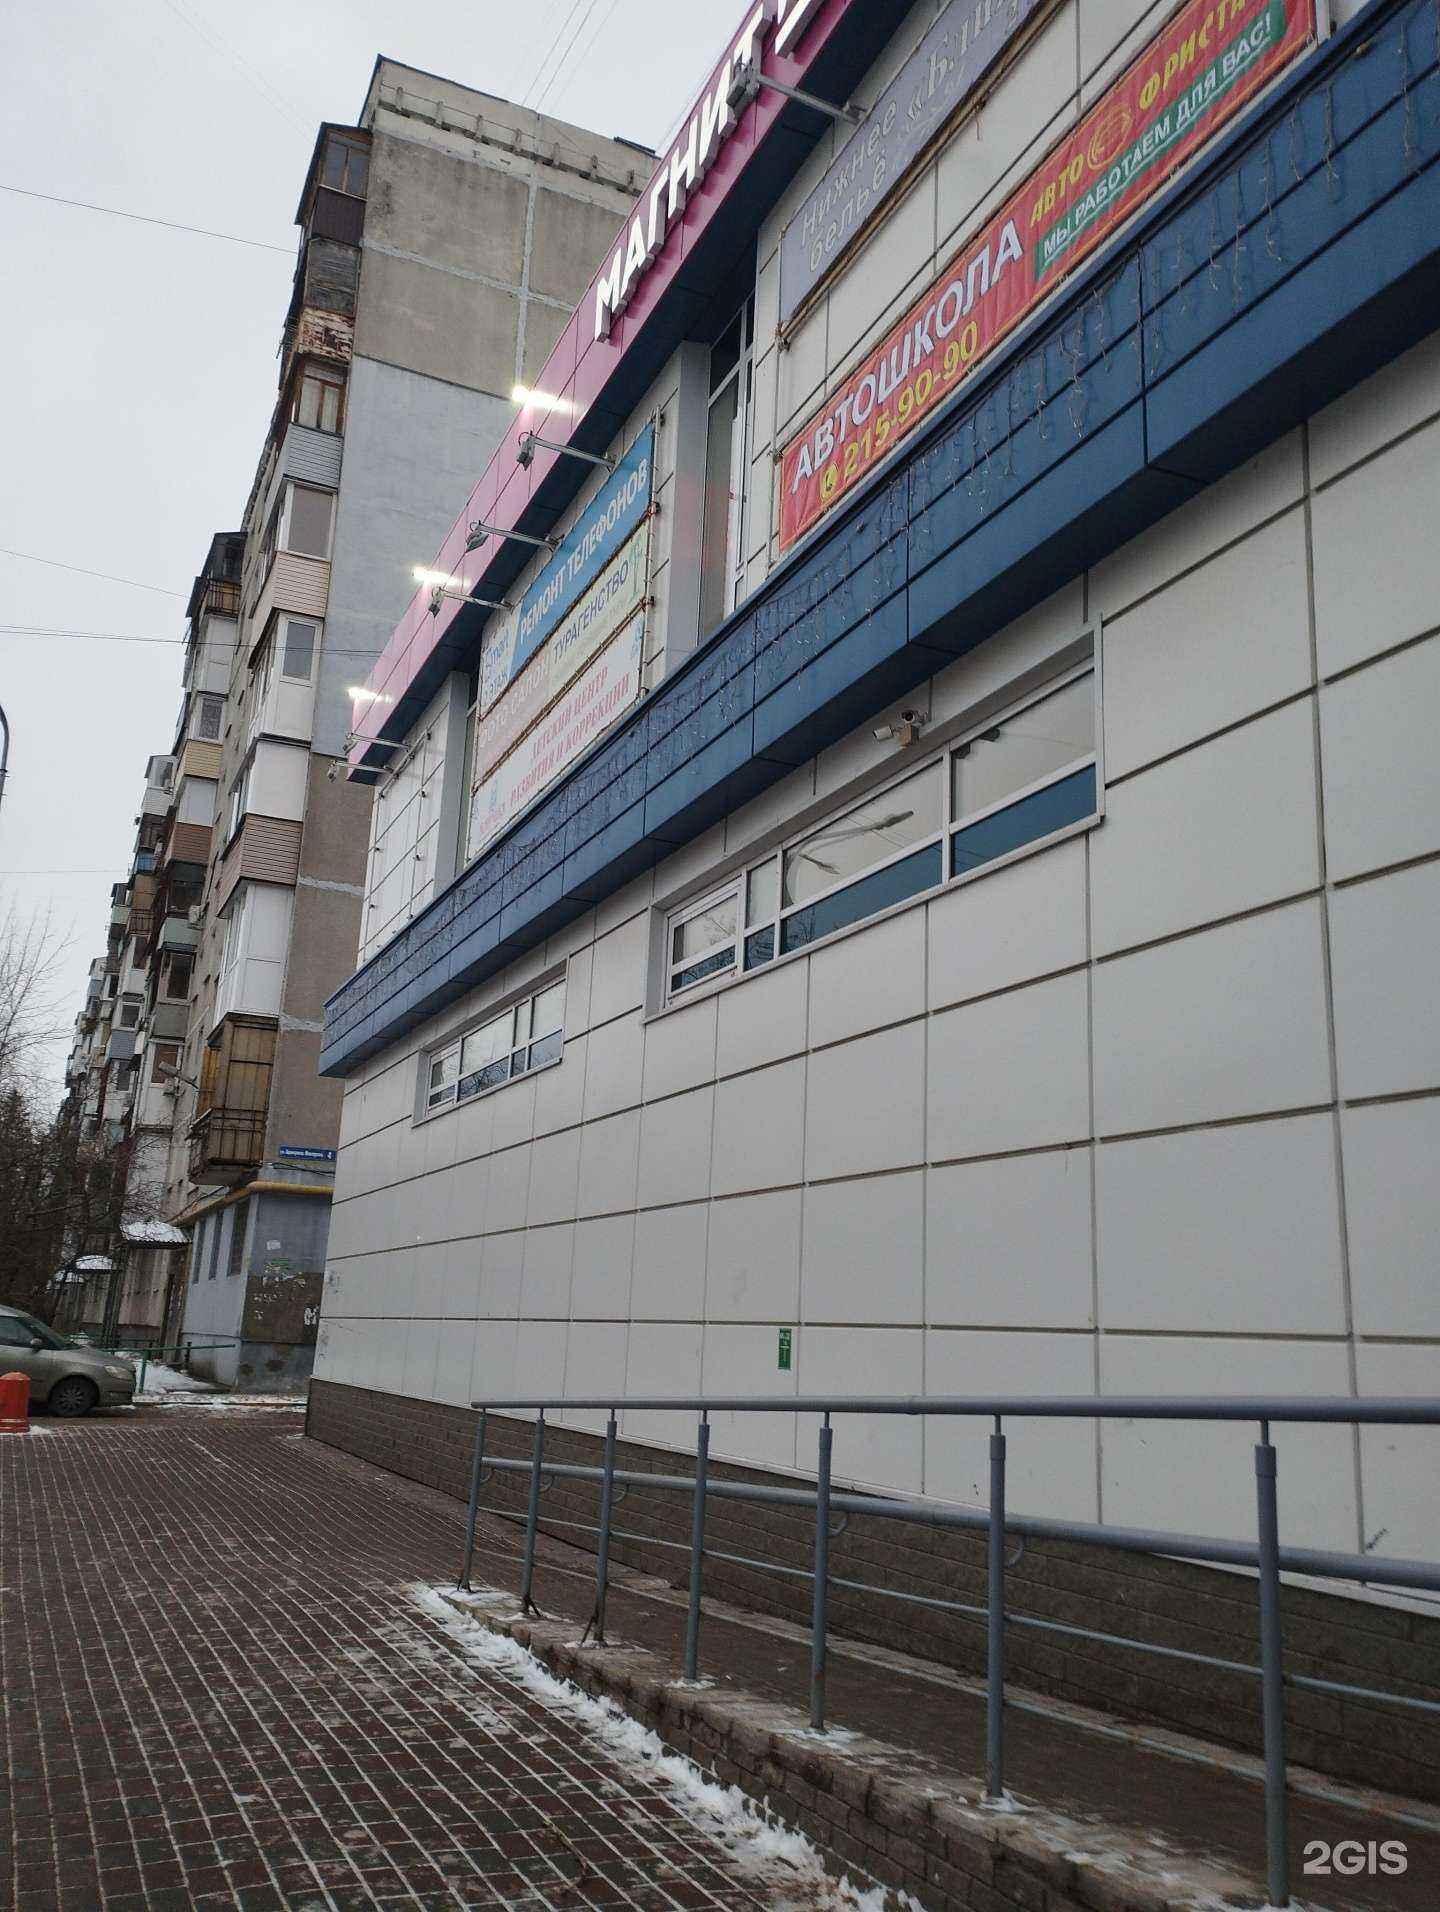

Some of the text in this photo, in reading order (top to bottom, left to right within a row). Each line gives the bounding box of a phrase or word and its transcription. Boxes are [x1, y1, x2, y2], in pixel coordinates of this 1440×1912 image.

[801, 100, 897, 246] Нижнее
[1030, 154, 1085, 228] АВТО
[1043, 12, 1272, 259] МЫ РАБОТАЕМ ДЛЯ ВАС!
[810, 150, 887, 272] бельё
[792, 218, 1024, 494] АВТОШКОЛА
[520, 458, 648, 644] РЕМОНТ ТЕЛЕФОНОВ
[554, 559, 629, 664] ТУРАГЕНСТВО
[565, 672, 630, 752] КОРРЕКЦИИ
[574, 666, 608, 717] ЦЕНТР
